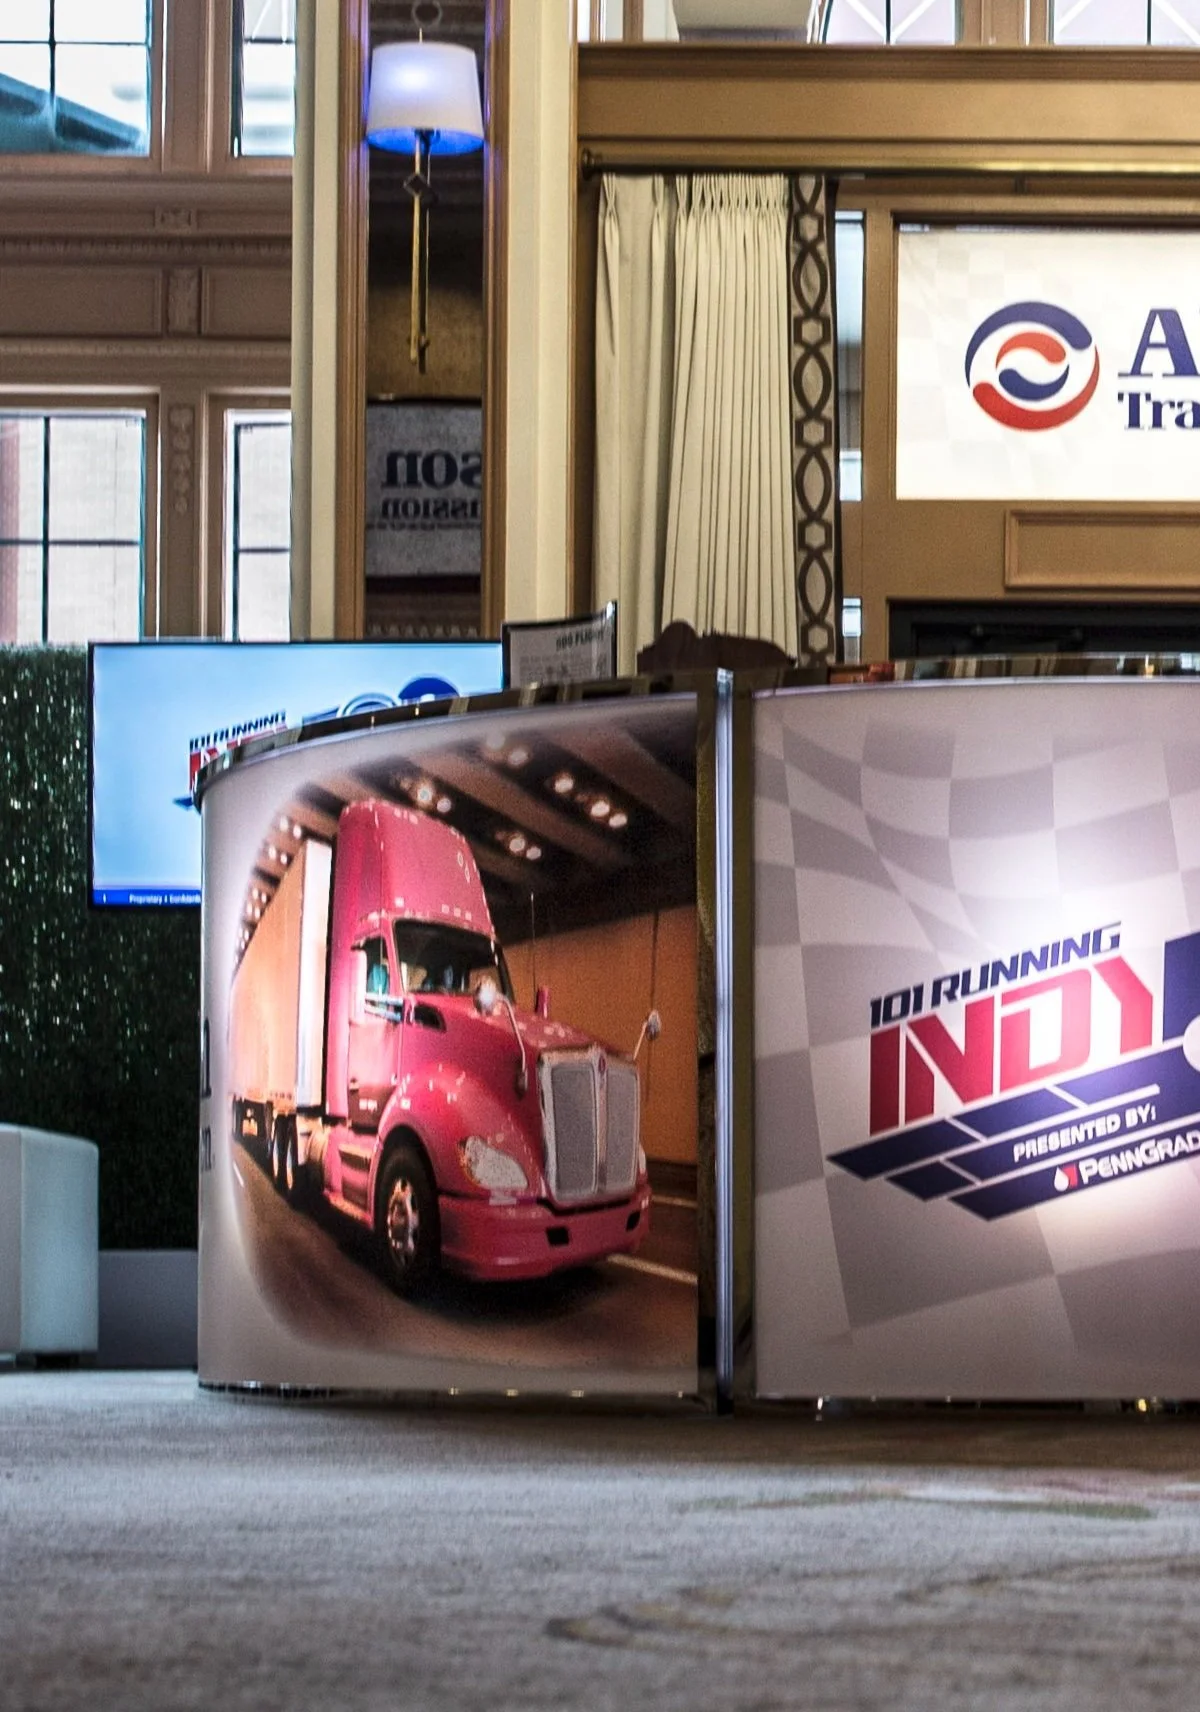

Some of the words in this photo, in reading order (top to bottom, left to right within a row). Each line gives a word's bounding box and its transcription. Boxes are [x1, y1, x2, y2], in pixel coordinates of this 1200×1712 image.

[871, 982, 924, 1030] 101
[931, 921, 1122, 1008] RUNNING
[869, 955, 1154, 1136] INDY
[1013, 1115, 1121, 1163] PRESENTED
[1125, 1102, 1156, 1128] BY:
